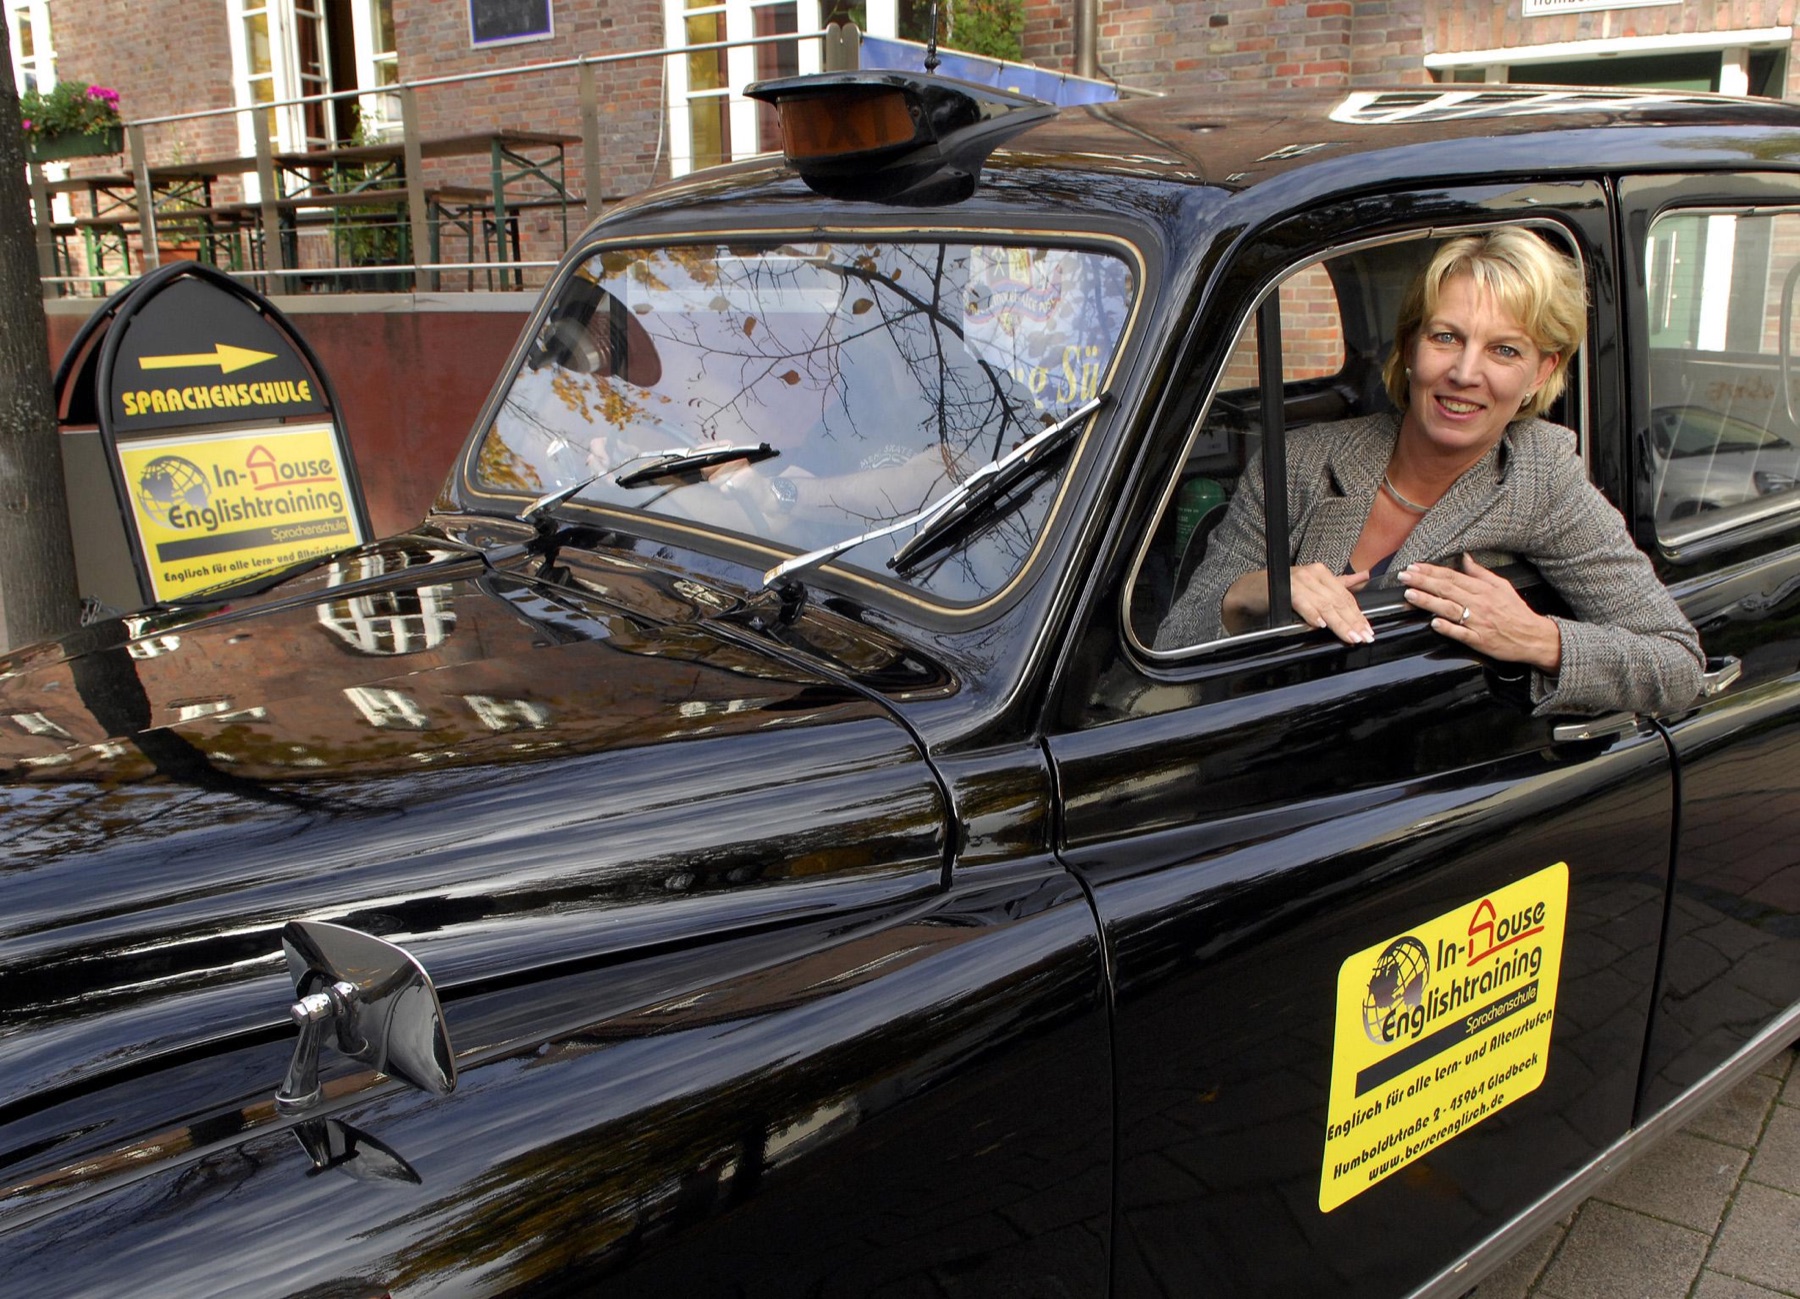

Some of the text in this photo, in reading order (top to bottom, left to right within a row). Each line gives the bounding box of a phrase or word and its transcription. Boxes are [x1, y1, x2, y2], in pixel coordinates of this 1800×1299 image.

[121, 380, 312, 416] SPRACHENSCHULE
[168, 488, 344, 531] Englishtraining
[271, 520, 347, 541] Sprachenschule
[164, 568, 210, 582] Englisch
[212, 563, 227, 573] für
[230, 559, 249, 570] alle
[277, 553, 295, 563] und
[1382, 945, 1543, 1042] Englishtraining
[1465, 985, 1538, 1035] Sprachenschule
[1327, 1009, 1553, 1142] Englisch für alle Lern- und Altersstufen
[1333, 1114, 1430, 1180] Humboldtstraße
[1433, 1107, 1440, 1122] 2
[1450, 1082, 1485, 1111] 45964
[1487, 1052, 1538, 1091] Gladbeck
[1368, 1093, 1505, 1181] www.besserenglisch.de
